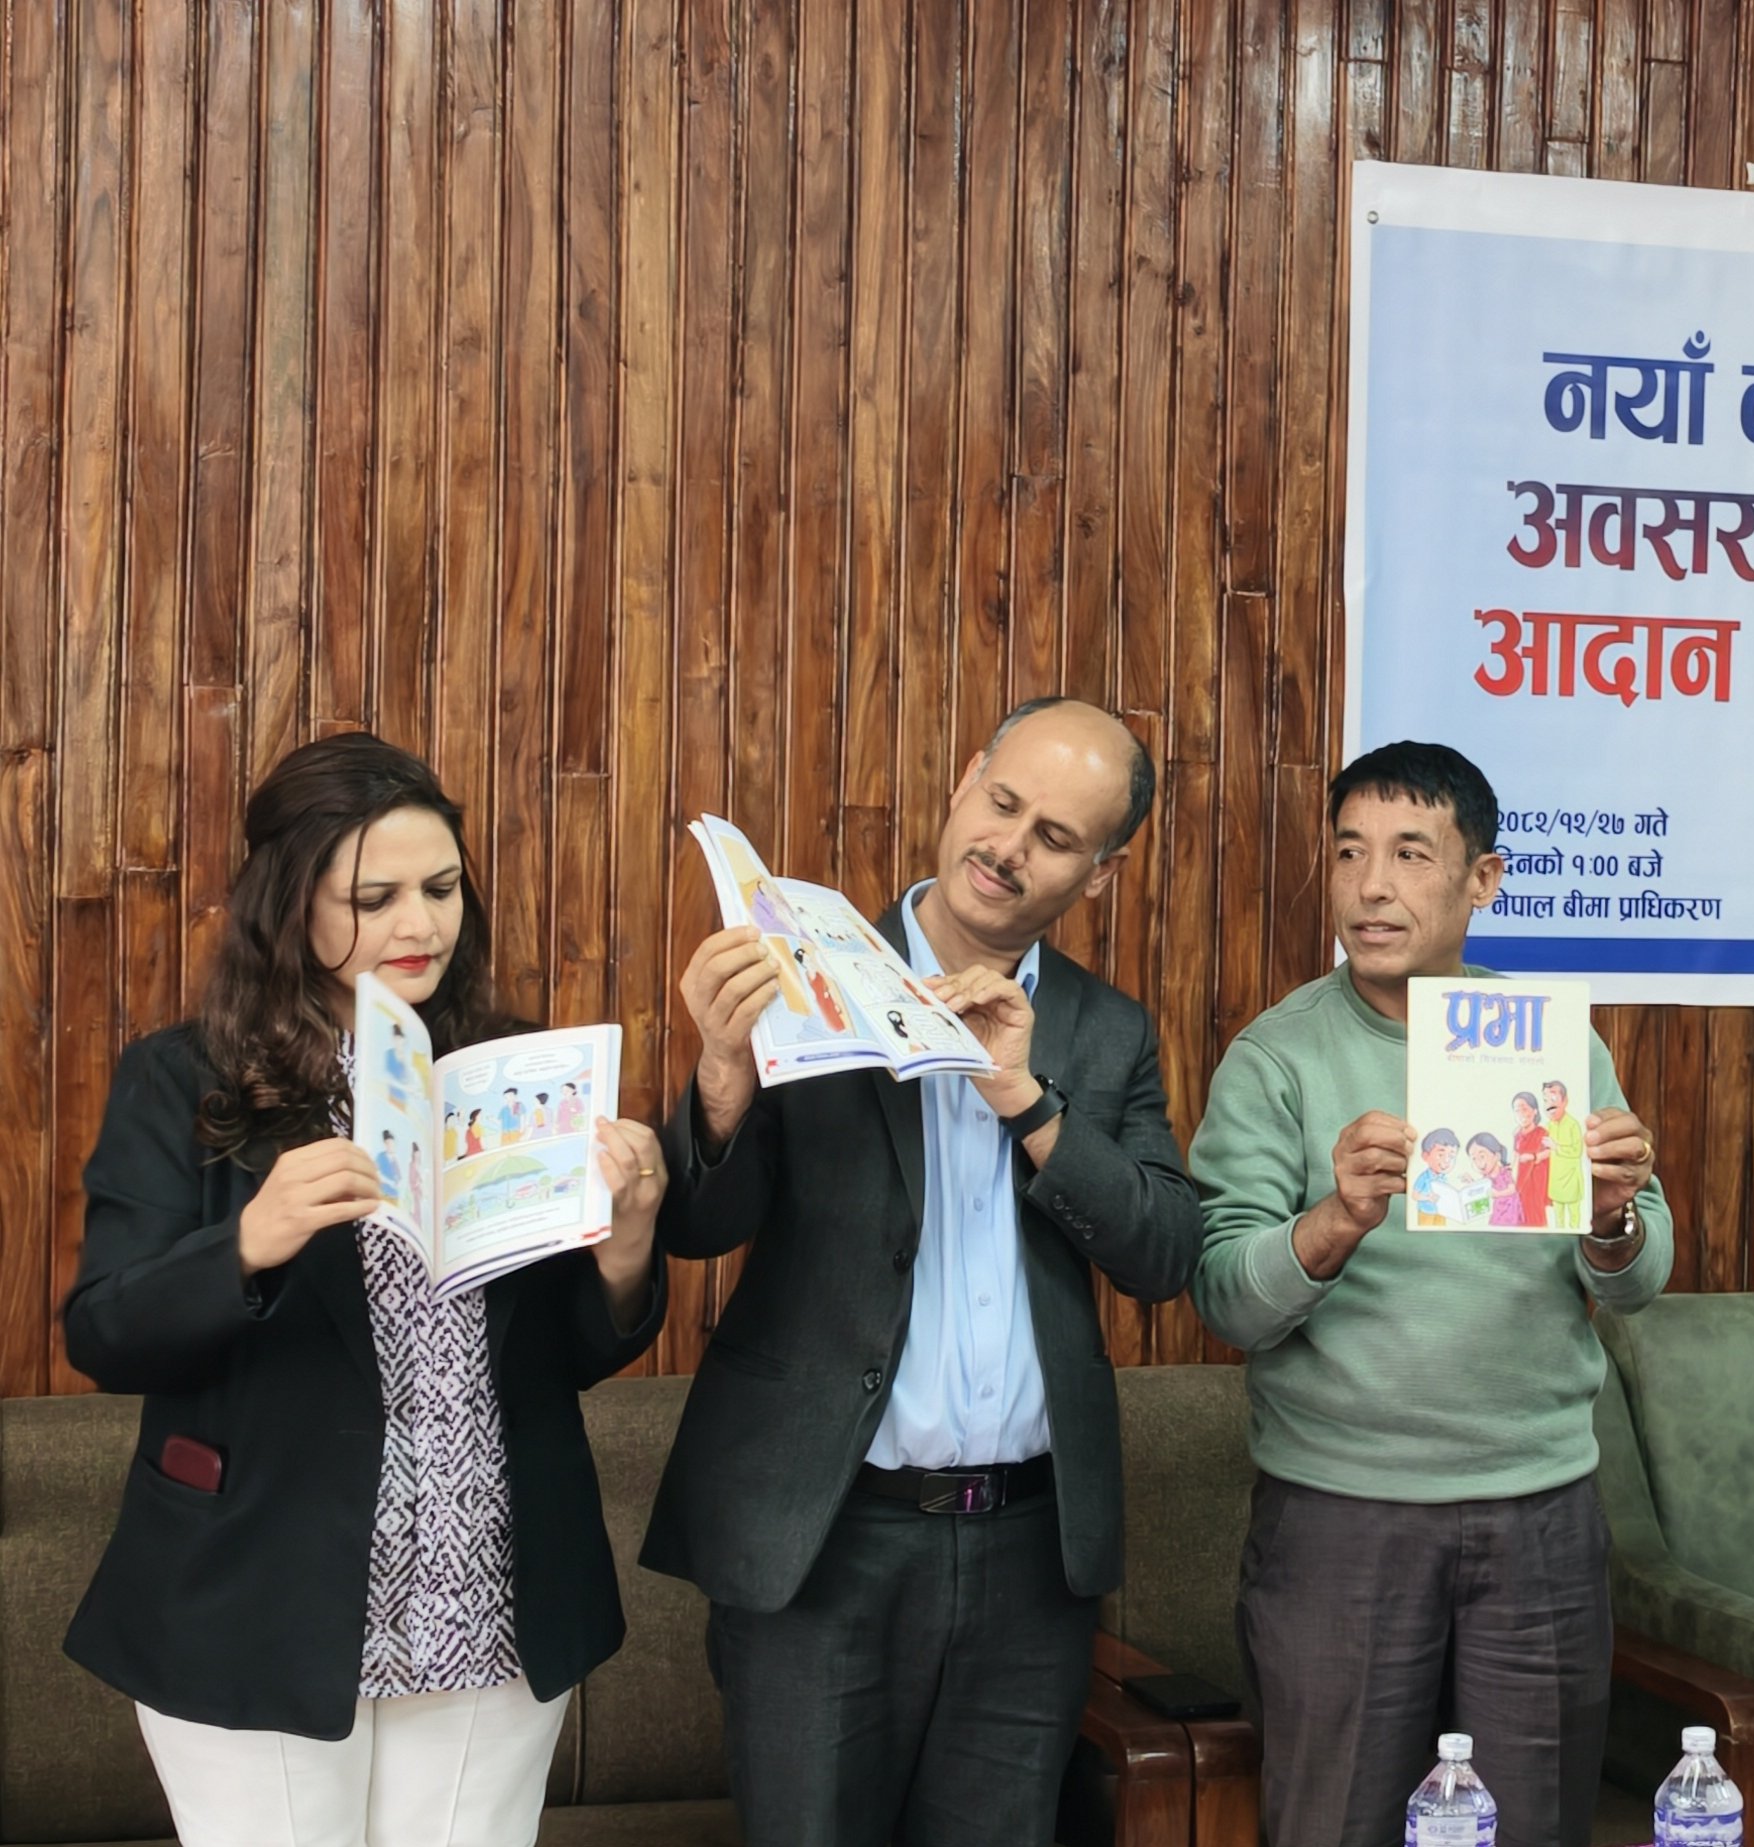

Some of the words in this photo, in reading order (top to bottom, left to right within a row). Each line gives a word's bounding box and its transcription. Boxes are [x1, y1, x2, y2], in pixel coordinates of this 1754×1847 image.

[1543, 331, 1714, 446] नयाँ
[1473, 609, 1742, 708] आदान
[1634, 807, 1669, 837] गते
[1627, 849, 1664, 878] बजे
[1491, 888, 1556, 918] नेपाल
[1563, 889, 1611, 919] बीमा
[1618, 889, 1722, 922] प्राधिकरण
[1441, 990, 1552, 1052] प्रभा
